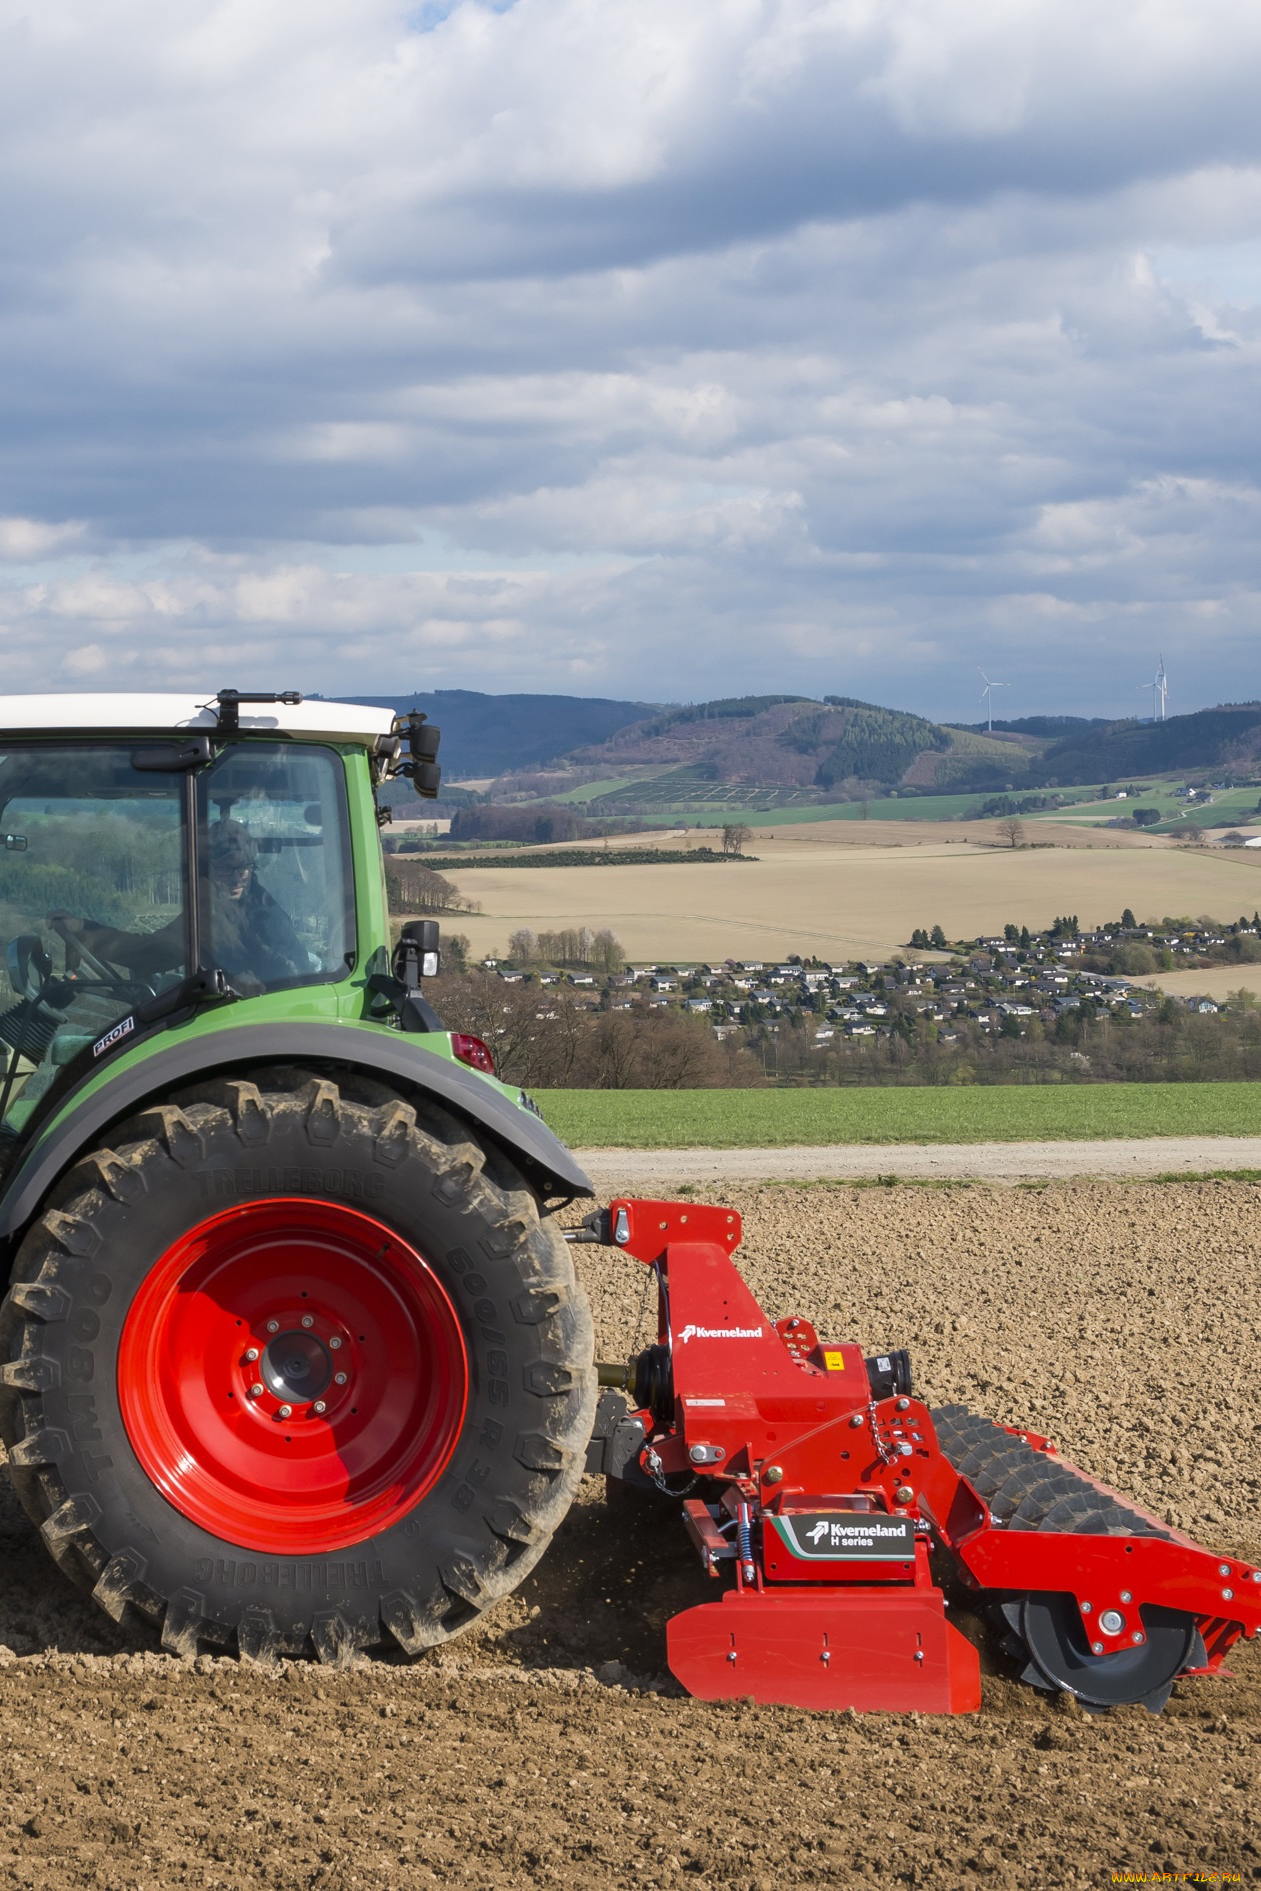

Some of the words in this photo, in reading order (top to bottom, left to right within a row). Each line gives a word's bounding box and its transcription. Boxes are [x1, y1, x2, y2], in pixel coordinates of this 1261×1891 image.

[94, 1018, 133, 1055] PROFI
[193, 1166, 387, 1198] TRELLEBORG
[696, 1326, 763, 1338] Kverneland
[451, 1457, 491, 1514] 38
[830, 1523, 907, 1537] Kverneland
[830, 1536, 840, 1546] H
[841, 1536, 874, 1547] series
[192, 1557, 390, 1590] TRELLEBORG
